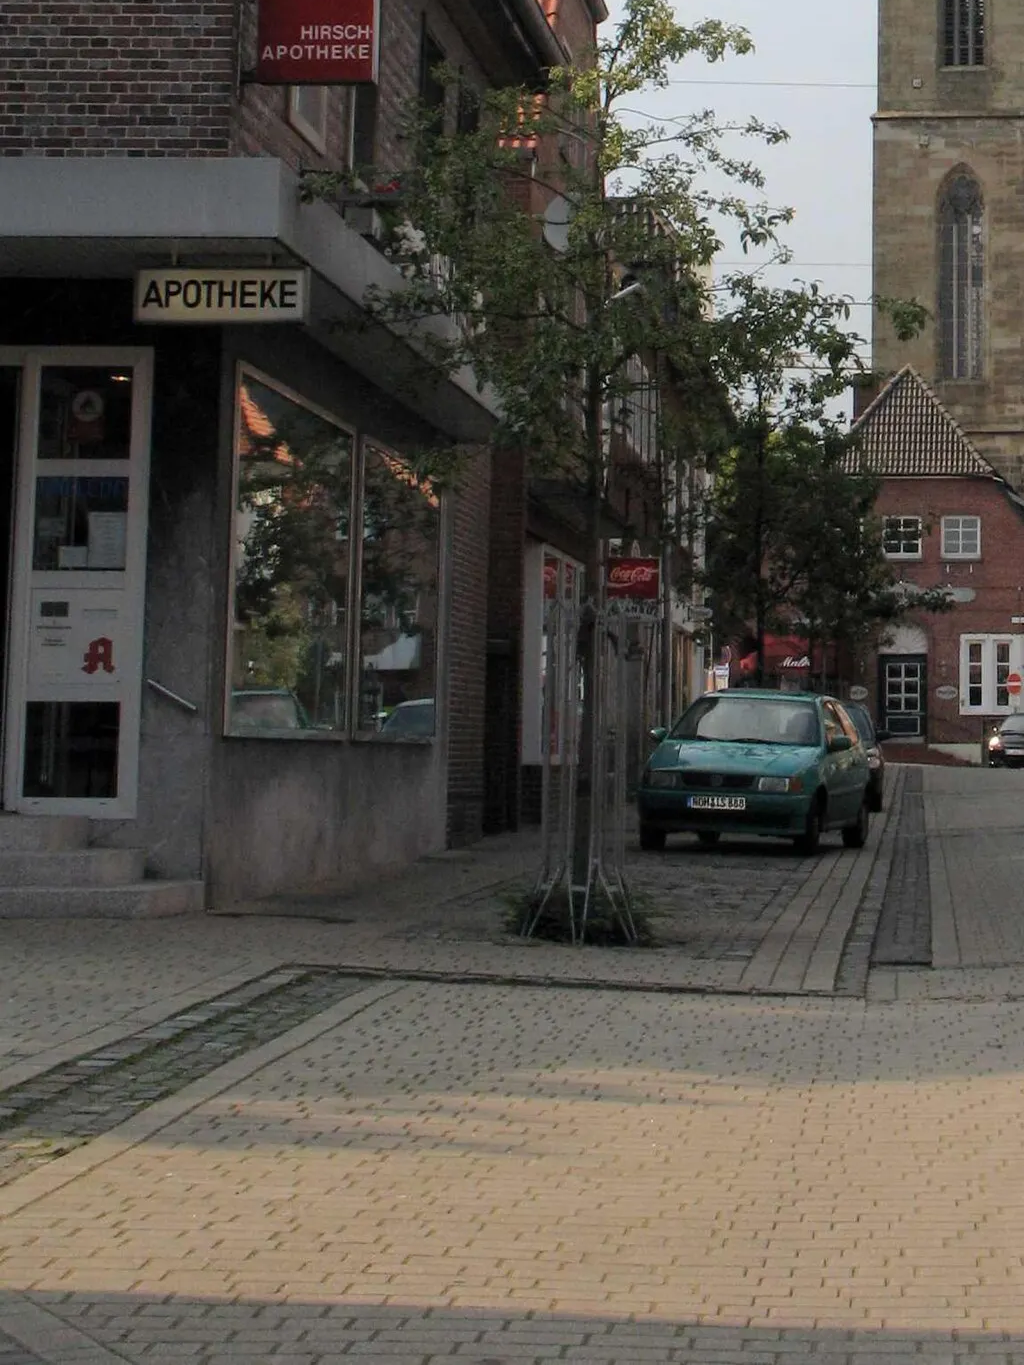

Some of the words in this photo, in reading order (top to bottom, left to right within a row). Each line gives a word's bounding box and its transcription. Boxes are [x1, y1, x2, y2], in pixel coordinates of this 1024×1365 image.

[301, 25, 373, 40] HIRSCH-
[262, 44, 370, 60] APOTHEKE
[142, 279, 297, 309] APOTHEKE
